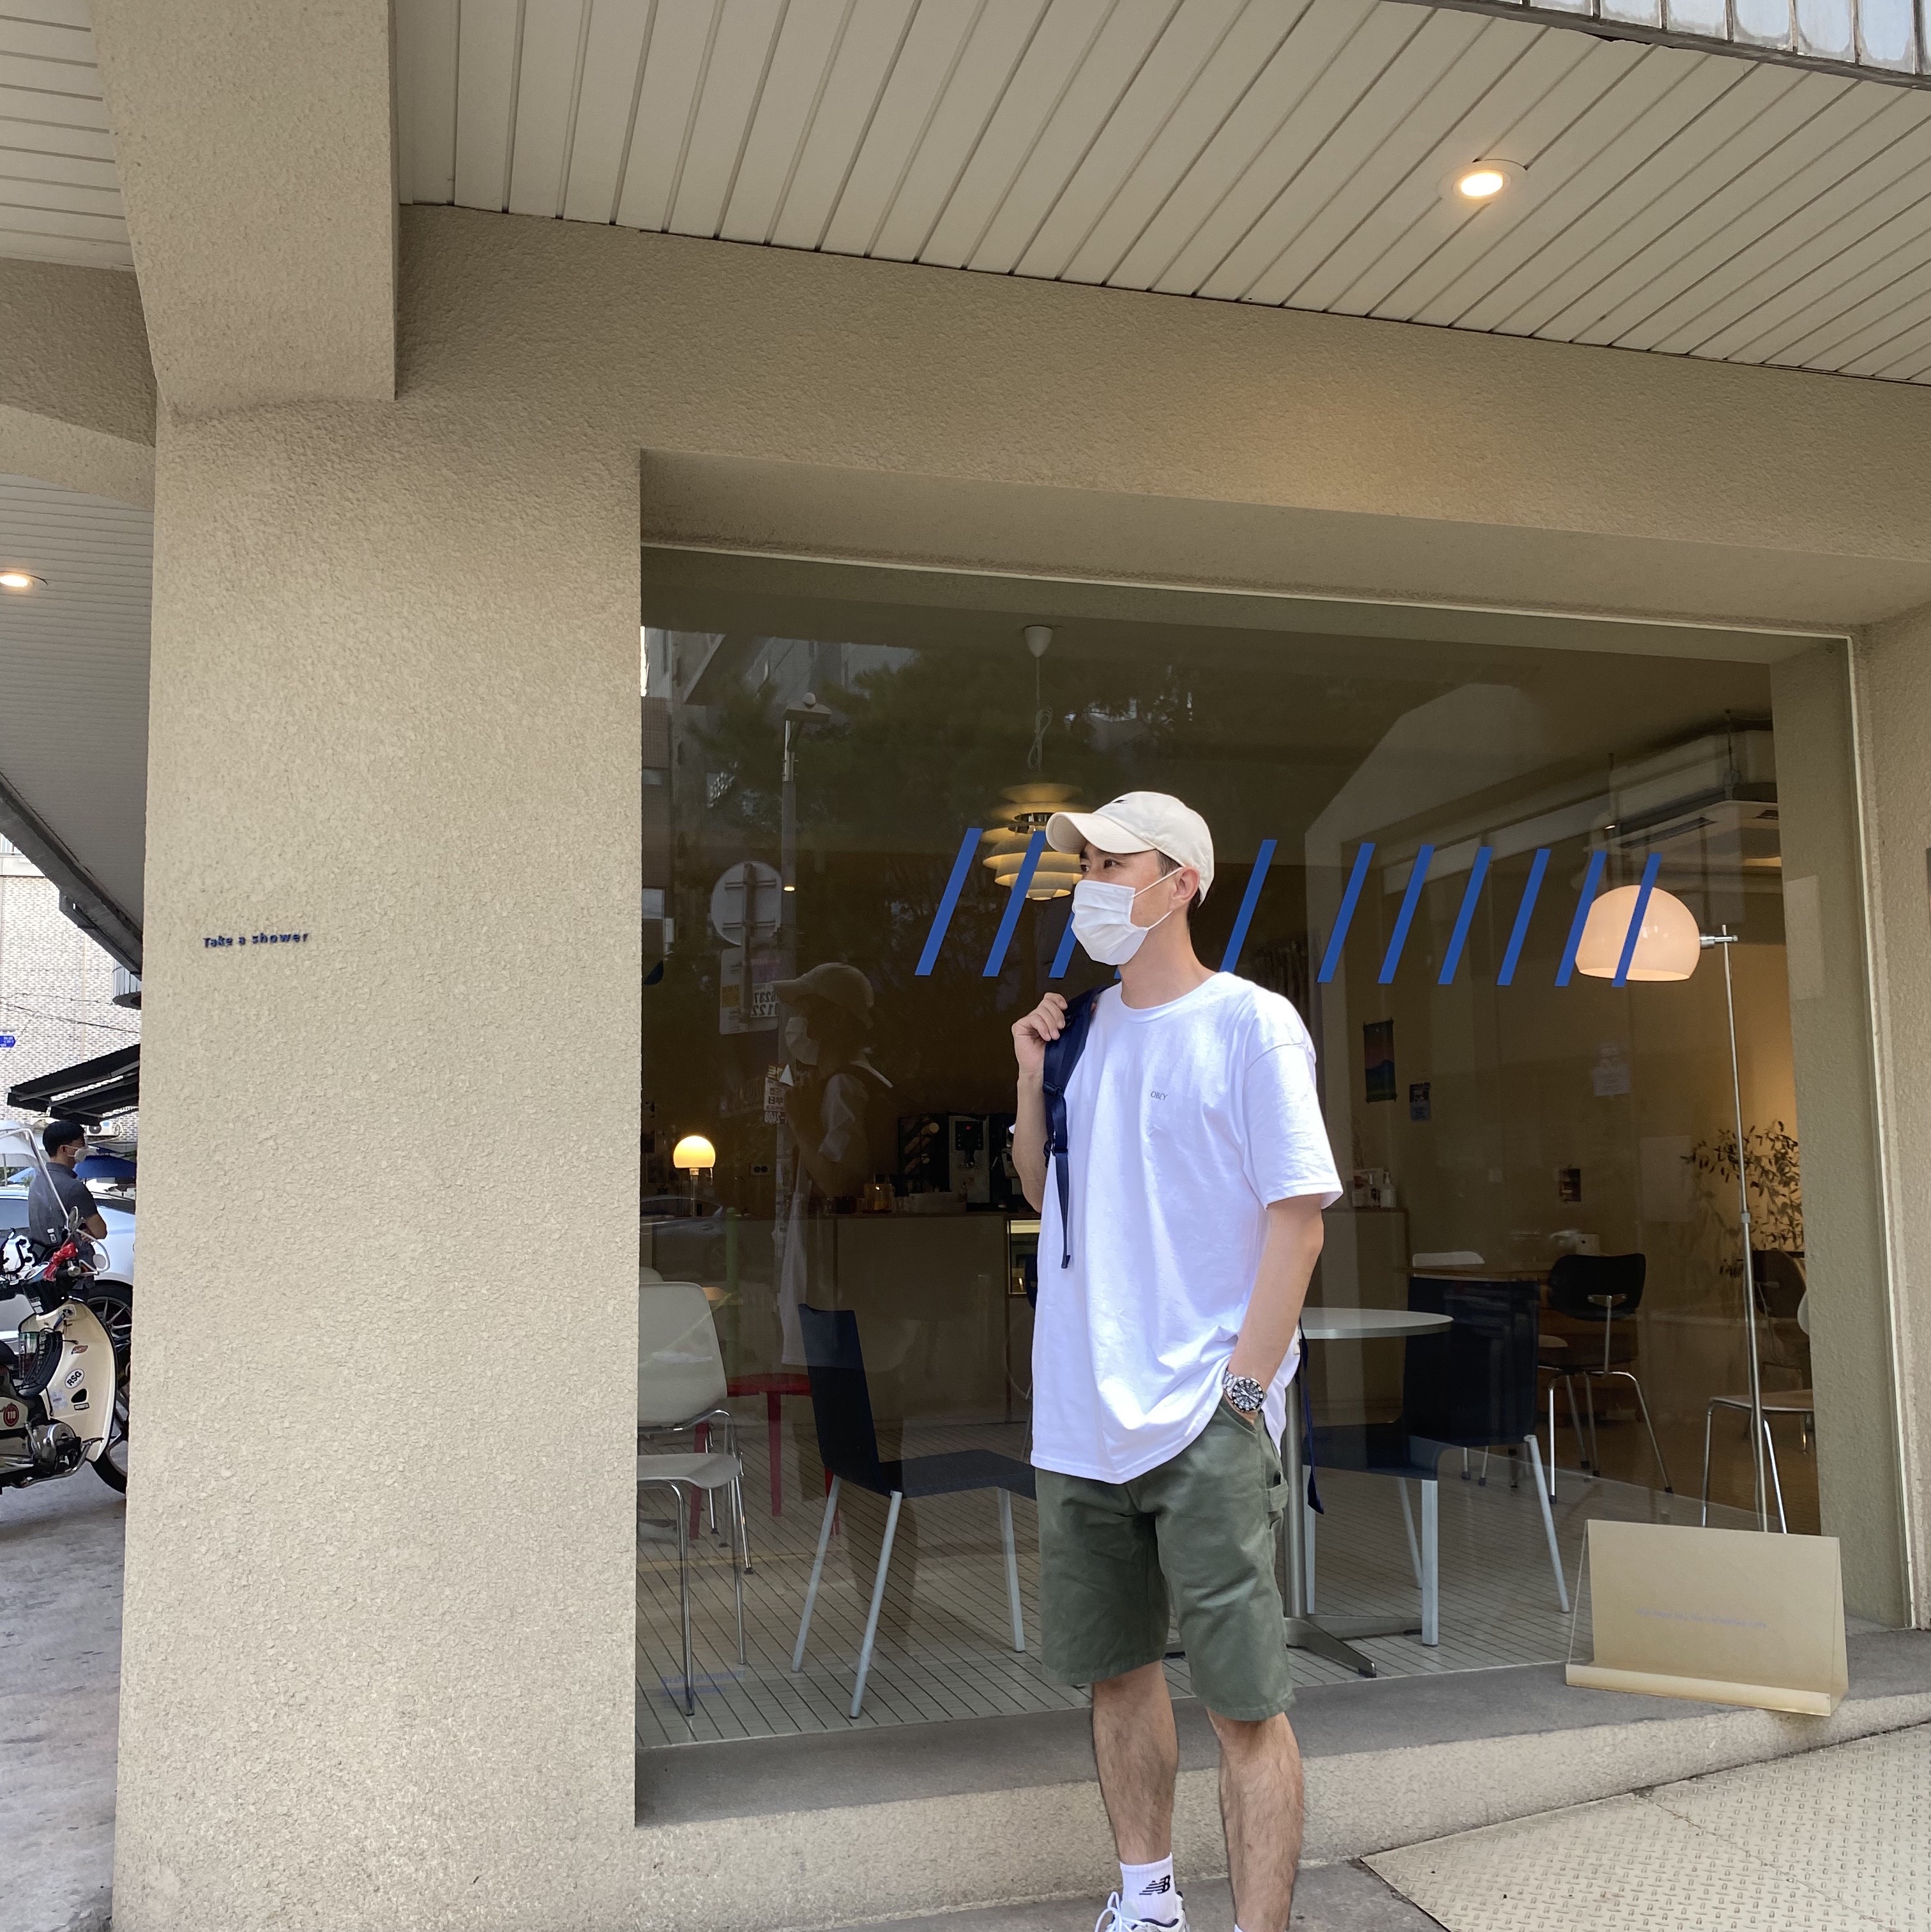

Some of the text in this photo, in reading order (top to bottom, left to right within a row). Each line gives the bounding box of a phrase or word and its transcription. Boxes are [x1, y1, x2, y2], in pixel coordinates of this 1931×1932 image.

[202, 932, 308, 948] Take a shower
[1150, 1091, 1168, 1101] OBEY
[66, 1371, 82, 1387] RSG
